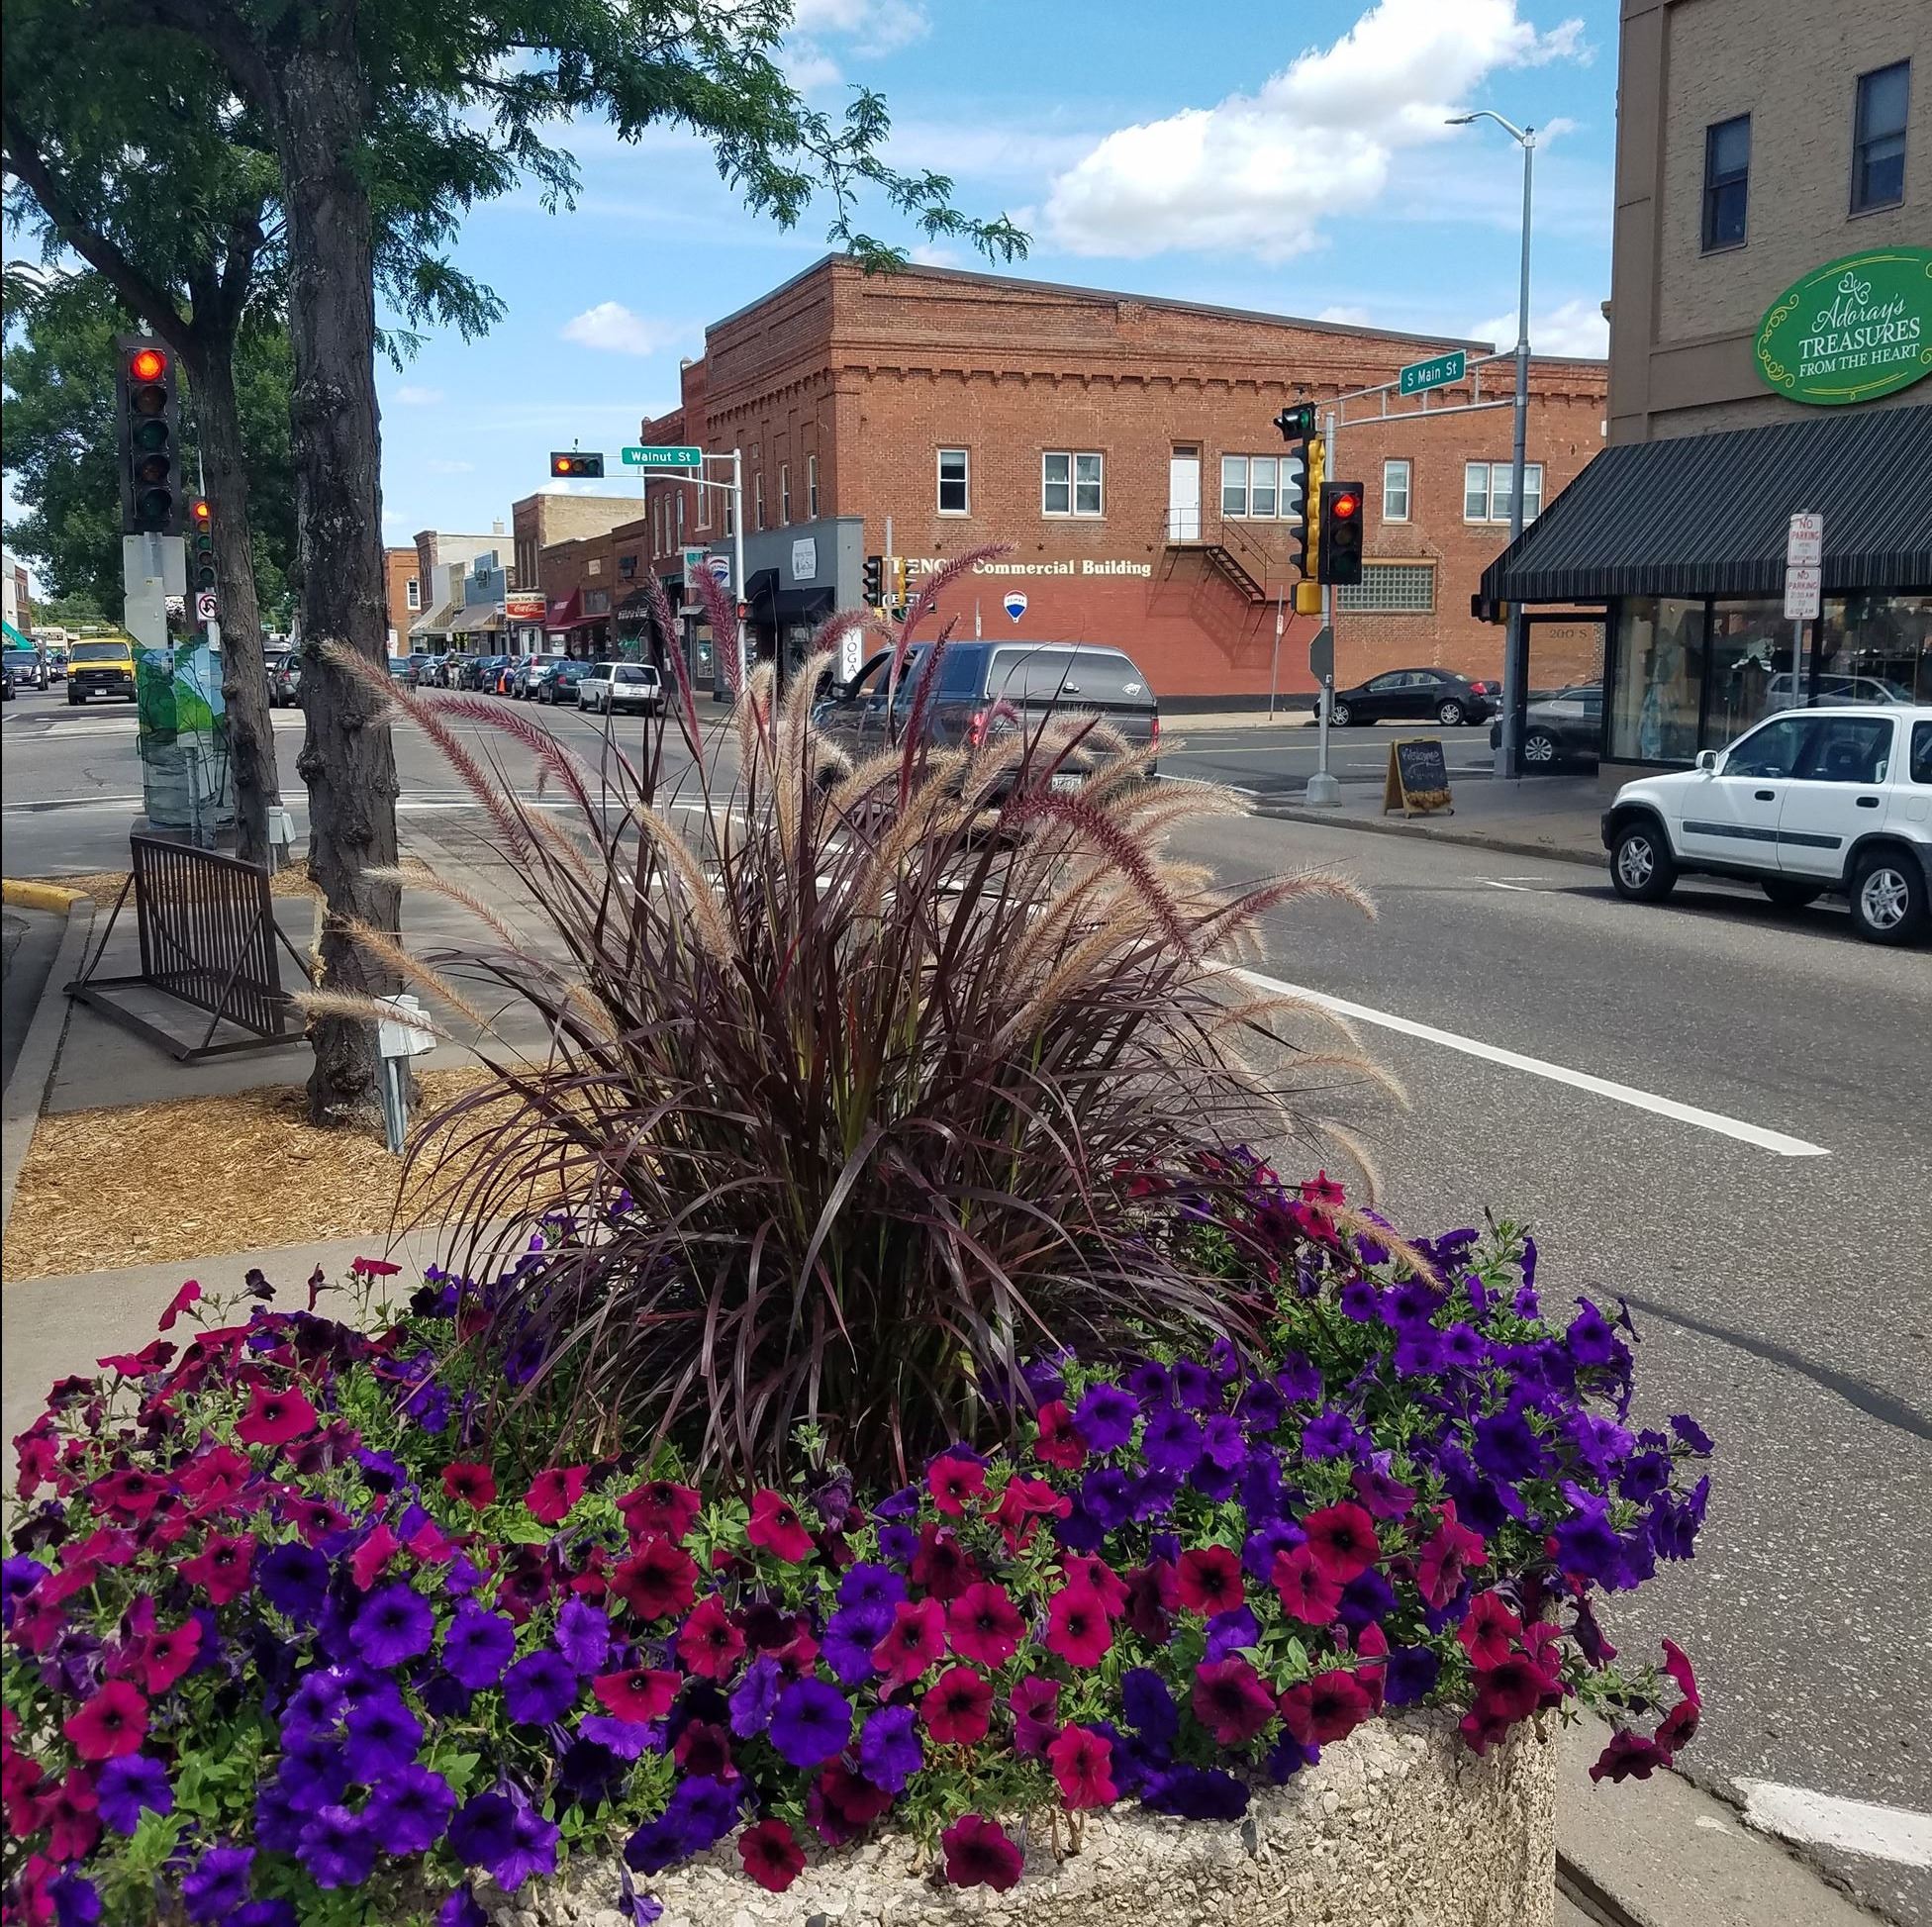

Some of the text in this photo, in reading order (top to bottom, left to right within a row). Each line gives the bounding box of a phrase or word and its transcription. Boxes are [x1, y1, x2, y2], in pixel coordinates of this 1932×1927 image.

[1812, 293, 1907, 339] Adoray's
[1798, 317, 1921, 360] TREASURES
[1799, 343, 1920, 378] FROM THE HEART
[1407, 360, 1457, 387] S Main St
[630, 451, 691, 462] Walnut St
[1790, 530, 1820, 540] PARKING
[1798, 520, 1813, 530] NO
[972, 559, 1075, 575] Commercial
[1082, 559, 1152, 577] Building
[1788, 581, 1818, 590] PARKING
[847, 628, 858, 674] YOGA
